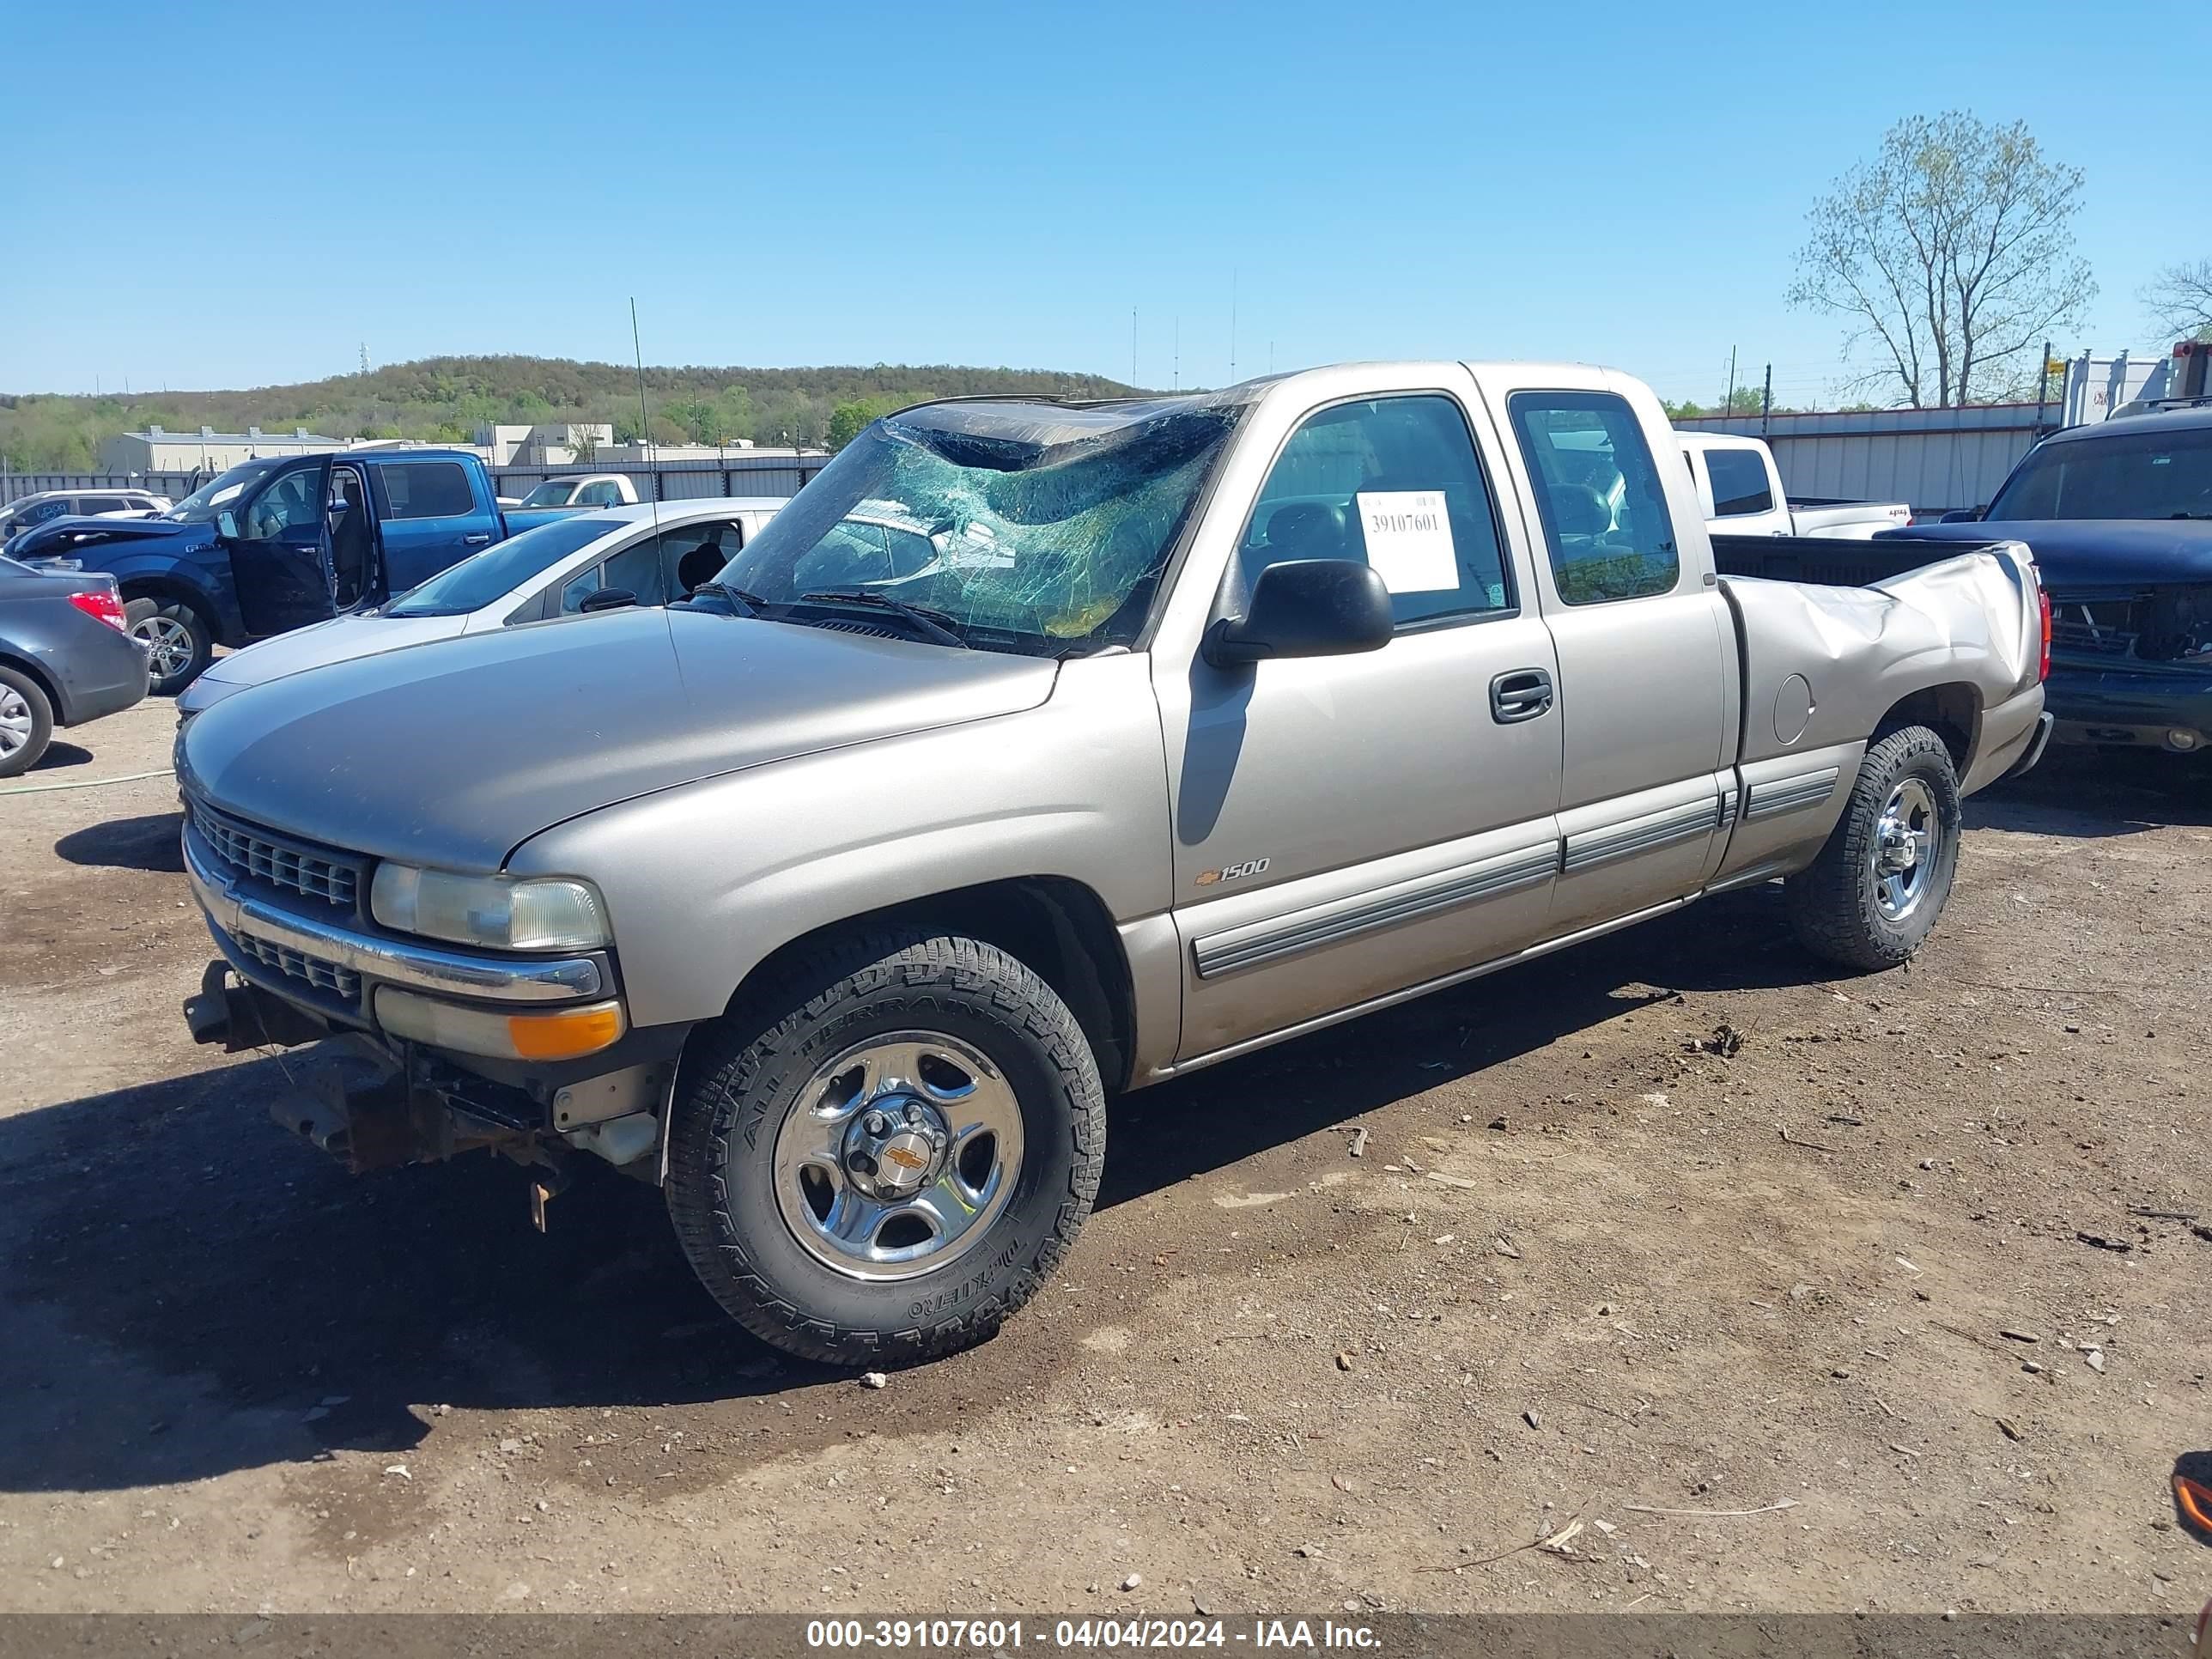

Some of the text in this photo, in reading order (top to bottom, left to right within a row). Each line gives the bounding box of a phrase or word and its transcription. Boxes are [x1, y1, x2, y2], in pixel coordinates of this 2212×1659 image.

[1371, 514, 1438, 533] 39107601
[1220, 857, 1271, 883] 1500
[743, 1070, 790, 1152] ALL
